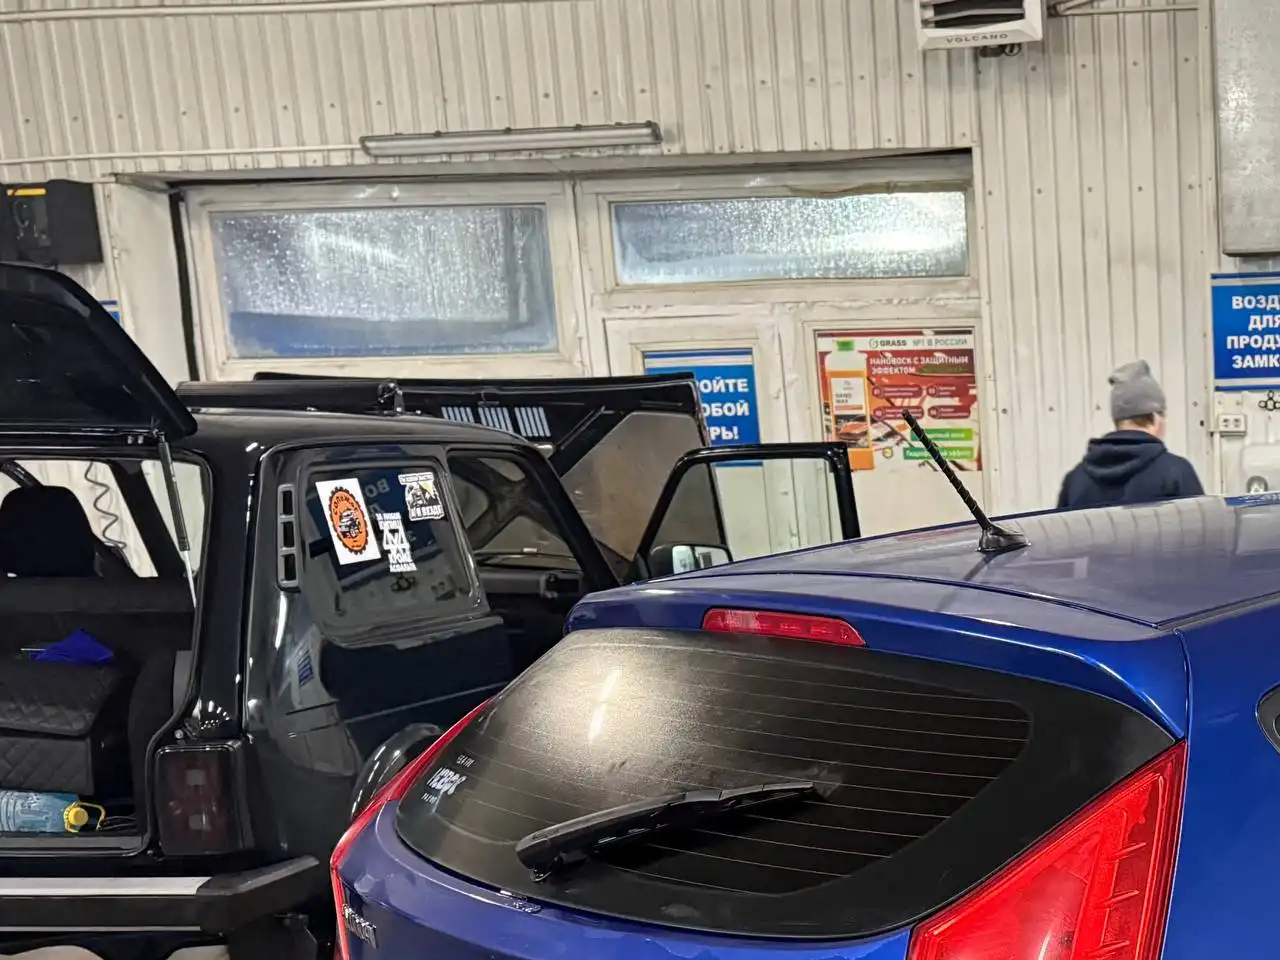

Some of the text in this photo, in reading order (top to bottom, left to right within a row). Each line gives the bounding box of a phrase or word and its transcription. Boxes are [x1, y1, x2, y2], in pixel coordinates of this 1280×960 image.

[946, 33, 1008, 43] VOLCANO
[920, 355, 969, 365] ЗАЩИТНЫМ
[871, 365, 916, 375] ЭФФЕКТОМ
